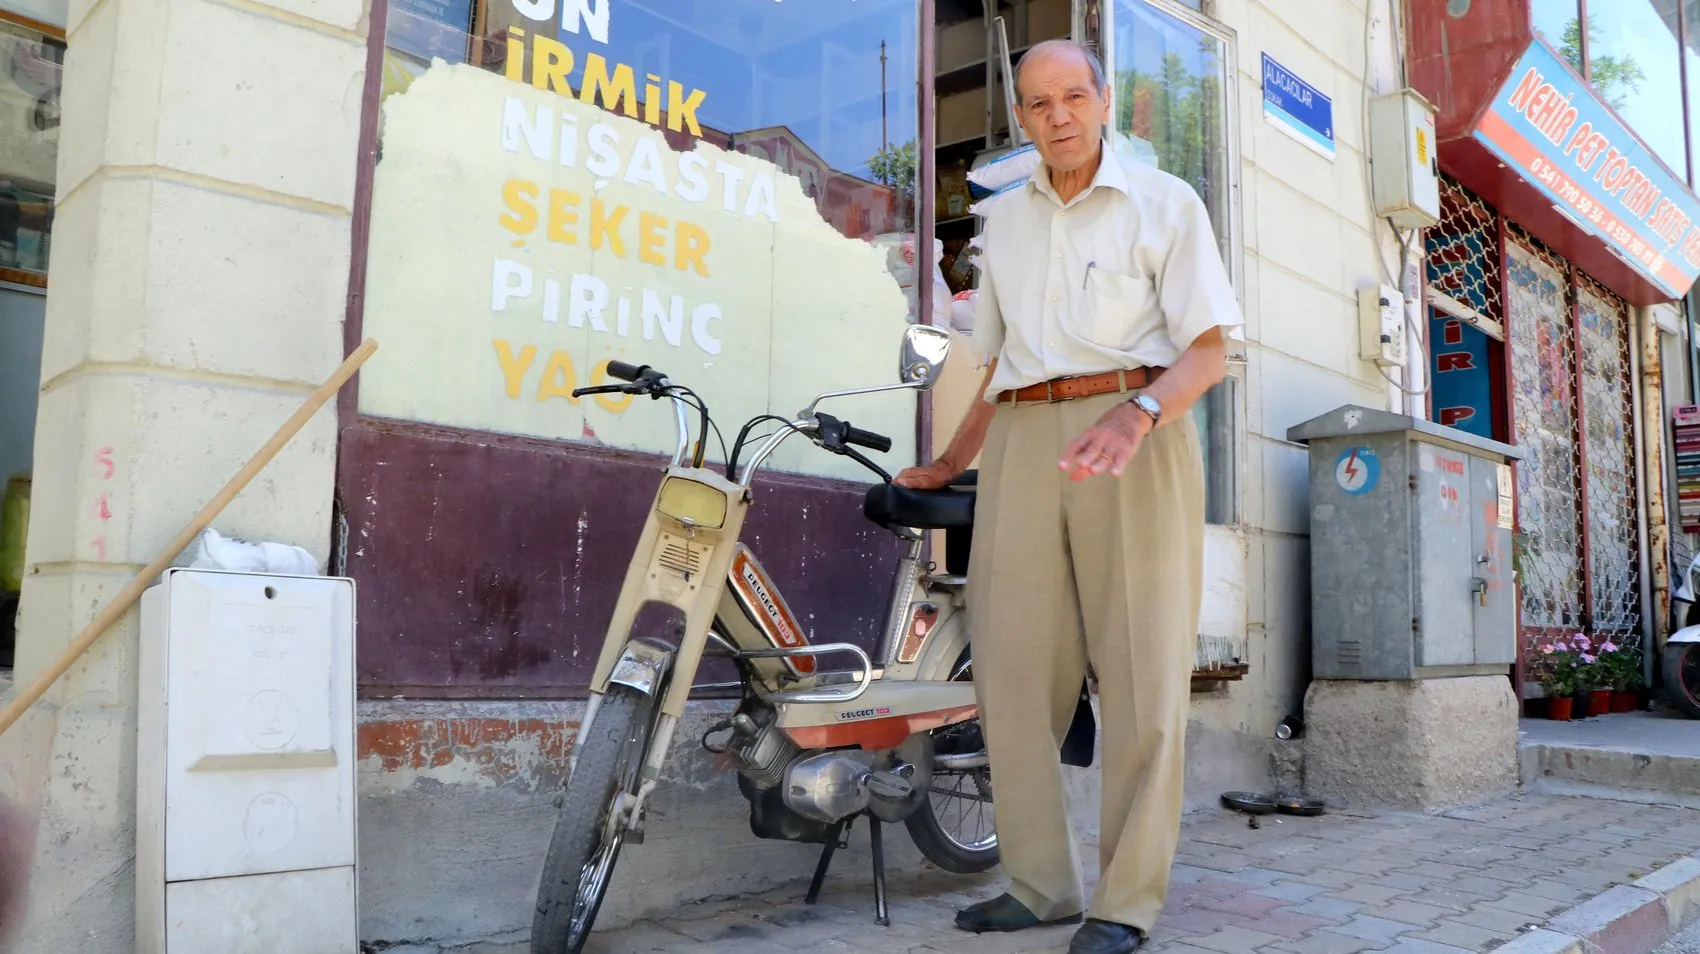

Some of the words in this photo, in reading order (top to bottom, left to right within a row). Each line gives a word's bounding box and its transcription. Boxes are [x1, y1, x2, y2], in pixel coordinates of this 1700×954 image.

[505, 25, 707, 137] İRMİK
[501, 96, 779, 223] NİŞASTA
[1508, 67, 1578, 147] NEHİR
[1563, 121, 1609, 172] PET
[1594, 146, 1662, 220] TOPTAN
[1530, 158, 1542, 172] 0
[1540, 165, 1562, 189] 541
[1559, 181, 1580, 203] 790
[1577, 196, 1593, 213] 50
[499, 179, 711, 278] ŞEKER
